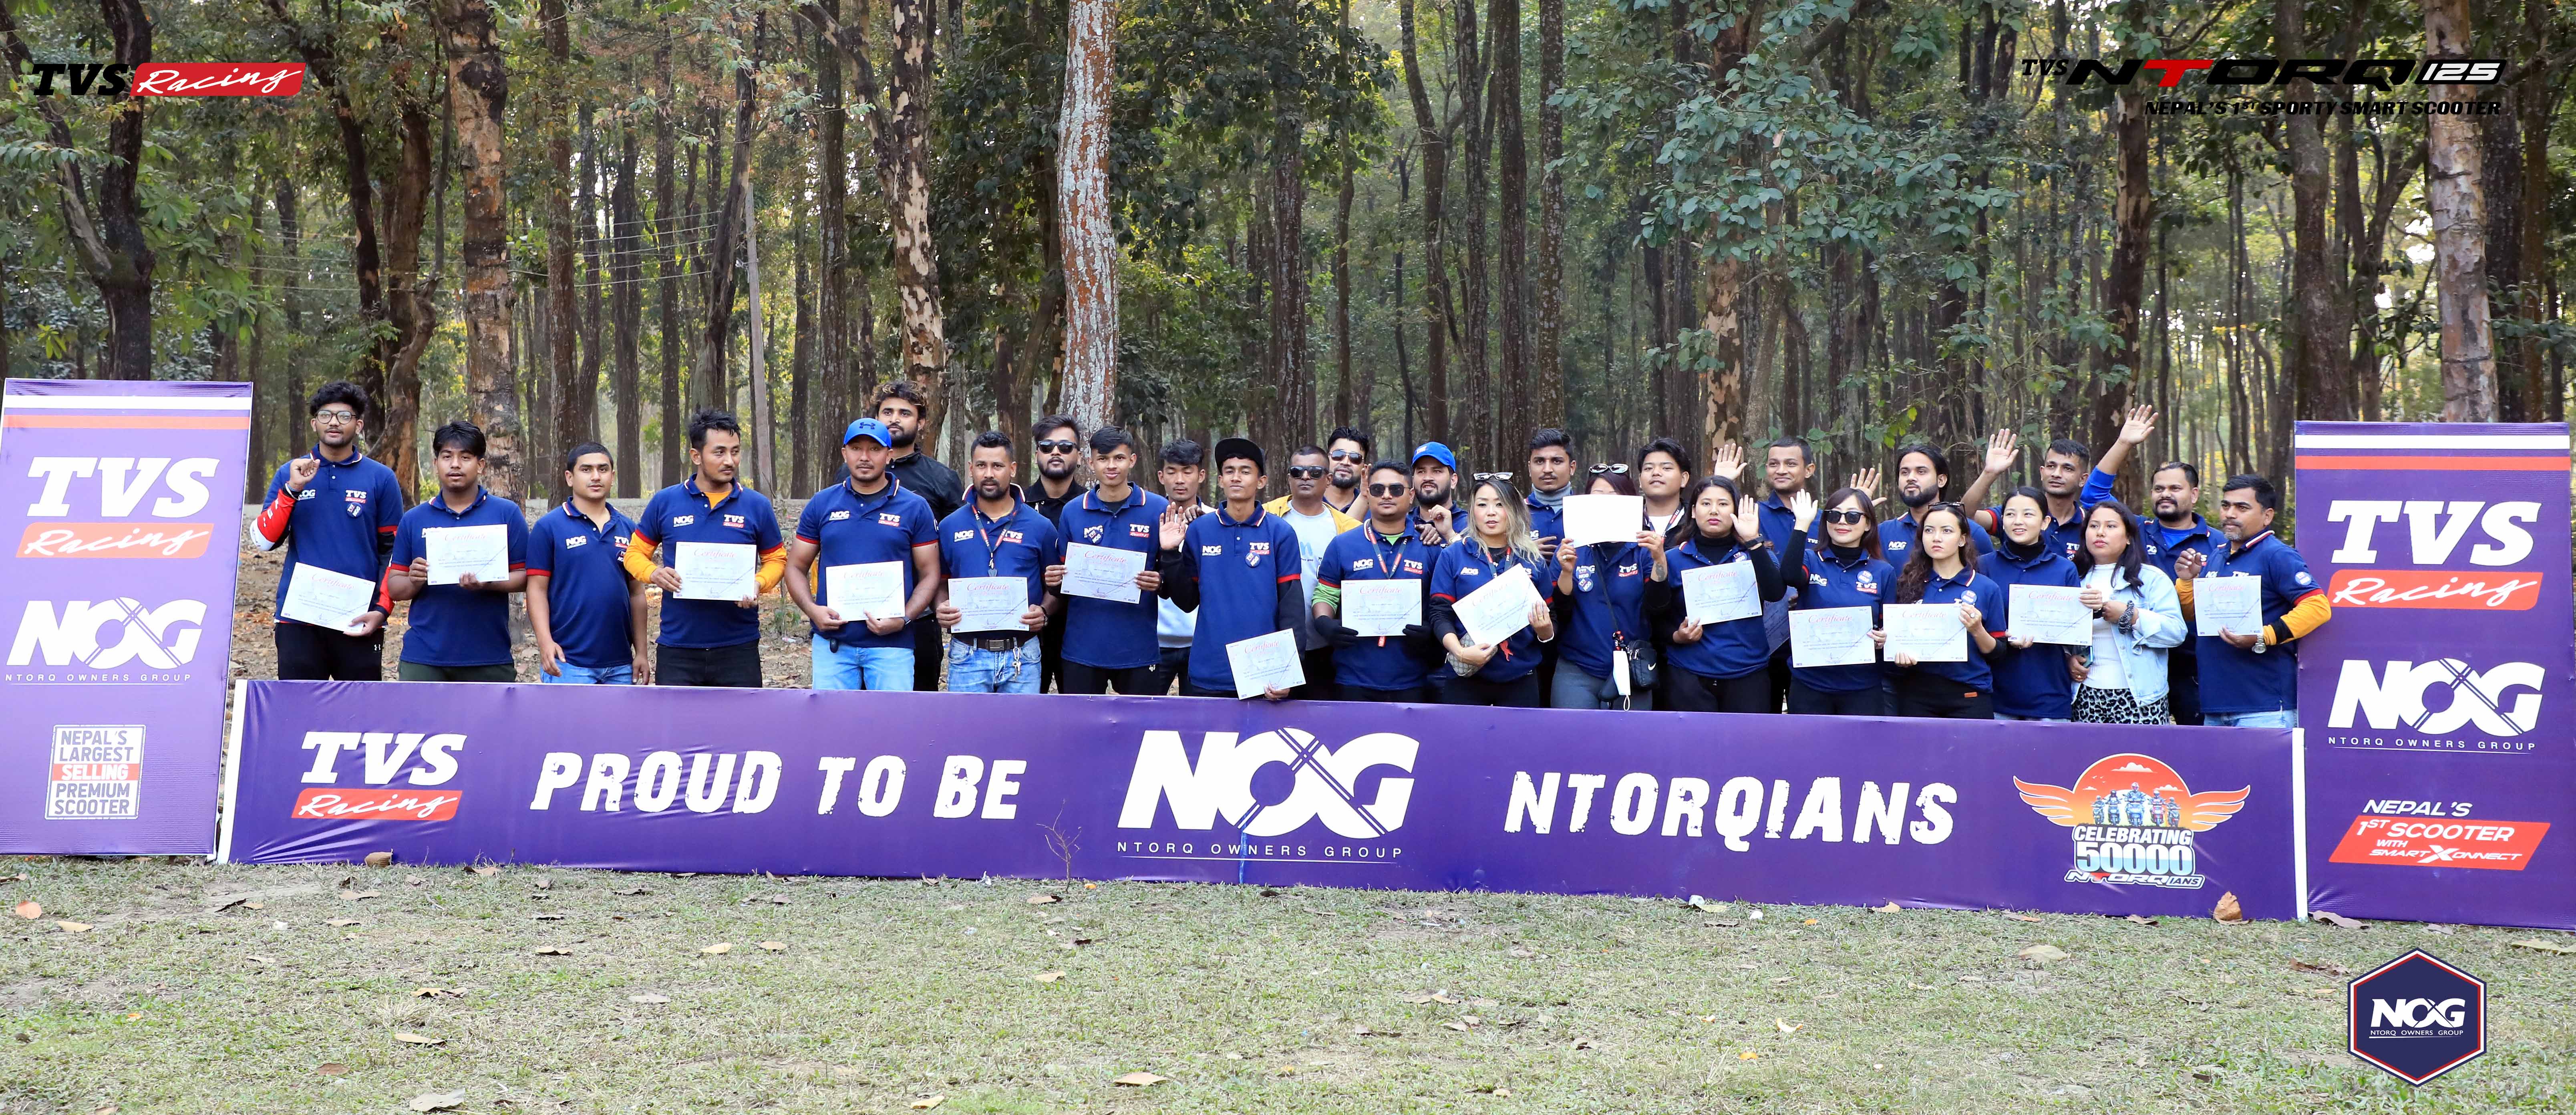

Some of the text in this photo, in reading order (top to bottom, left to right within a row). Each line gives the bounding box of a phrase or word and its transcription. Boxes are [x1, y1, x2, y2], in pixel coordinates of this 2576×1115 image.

[26, 457, 220, 518] TVS
[301, 489, 367, 499] OG TVS
[674, 514, 745, 524] NOG TVS
[879, 513, 900, 523] TVS
[954, 530, 974, 539] NOG
[1130, 524, 1150, 533] TVS
[2327, 500, 2542, 566] TVS
[24, 528, 209, 556] Racing
[566, 535, 587, 547] NOG
[1202, 542, 1270, 553] NOG TVS
[2066, 542, 2080, 551] TV
[694, 547, 735, 559] Certificate
[1085, 550, 1127, 563] Certificate
[1353, 559, 1423, 570] NOG TVS
[1619, 563, 1637, 573] TVS
[1698, 570, 1738, 582] Certificate
[1809, 574, 1827, 586] NOG
[967, 583, 1010, 592] Certificate
[1359, 585, 1403, 596] Certificate
[2208, 583, 2244, 592] Certificate
[2332, 577, 2538, 607] Racing
[2029, 591, 2073, 602] Certificate
[1808, 613, 1852, 624] Certificate
[6, 597, 207, 669] NOG
[1244, 641, 1280, 654] Certificate
[5, 674, 57, 682] NTORQ
[2327, 658, 2546, 737] NOG
[61, 730, 127, 745] NEPAL'S
[2328, 737, 2536, 750] NTORQ OWNERS GROUP
[60, 747, 133, 762] LARGEST
[300, 731, 468, 786] TVS
[61, 765, 129, 780] SELLING
[529, 750, 1027, 819] PROUD TO BE
[1117, 727, 1420, 839] NOG
[56, 783, 130, 798] PREMIUM
[54, 799, 129, 815] SCOOTER
[298, 794, 458, 818] Racing
[1503, 771, 1958, 852] NTORQIANS
[2363, 799, 2473, 817] NEPAL'S
[2074, 826, 2192, 845] CELEBRATING
[2387, 823, 2515, 841] SCOOTER
[2376, 839, 2408, 847] WITH
[1117, 842, 1403, 858] NTORQ OWNERS GROUP
[2077, 841, 2193, 875] 50000
